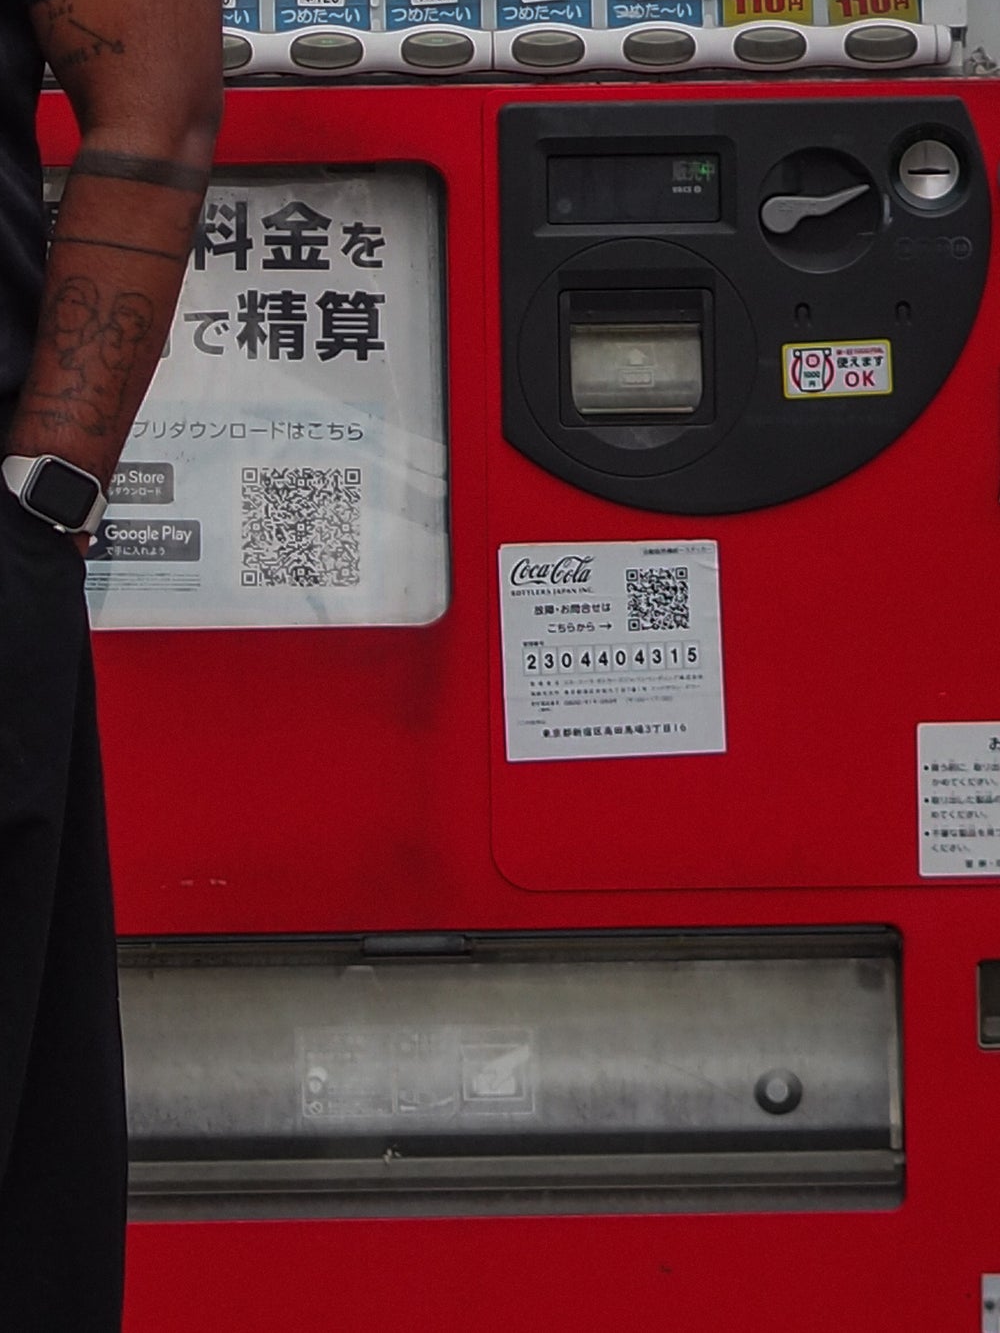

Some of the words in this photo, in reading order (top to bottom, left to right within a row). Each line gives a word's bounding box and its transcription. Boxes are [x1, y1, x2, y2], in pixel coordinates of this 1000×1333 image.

[162, 289, 386, 362] で精算
[837, 356, 884, 368] 使えます
[845, 370, 875, 387] OK
[132, 421, 364, 441] プリダウンロードはこちら
[128, 470, 165, 484] Store
[105, 525, 159, 544] Google
[162, 525, 192, 545] Play
[547, 622, 596, 634] こちらから
